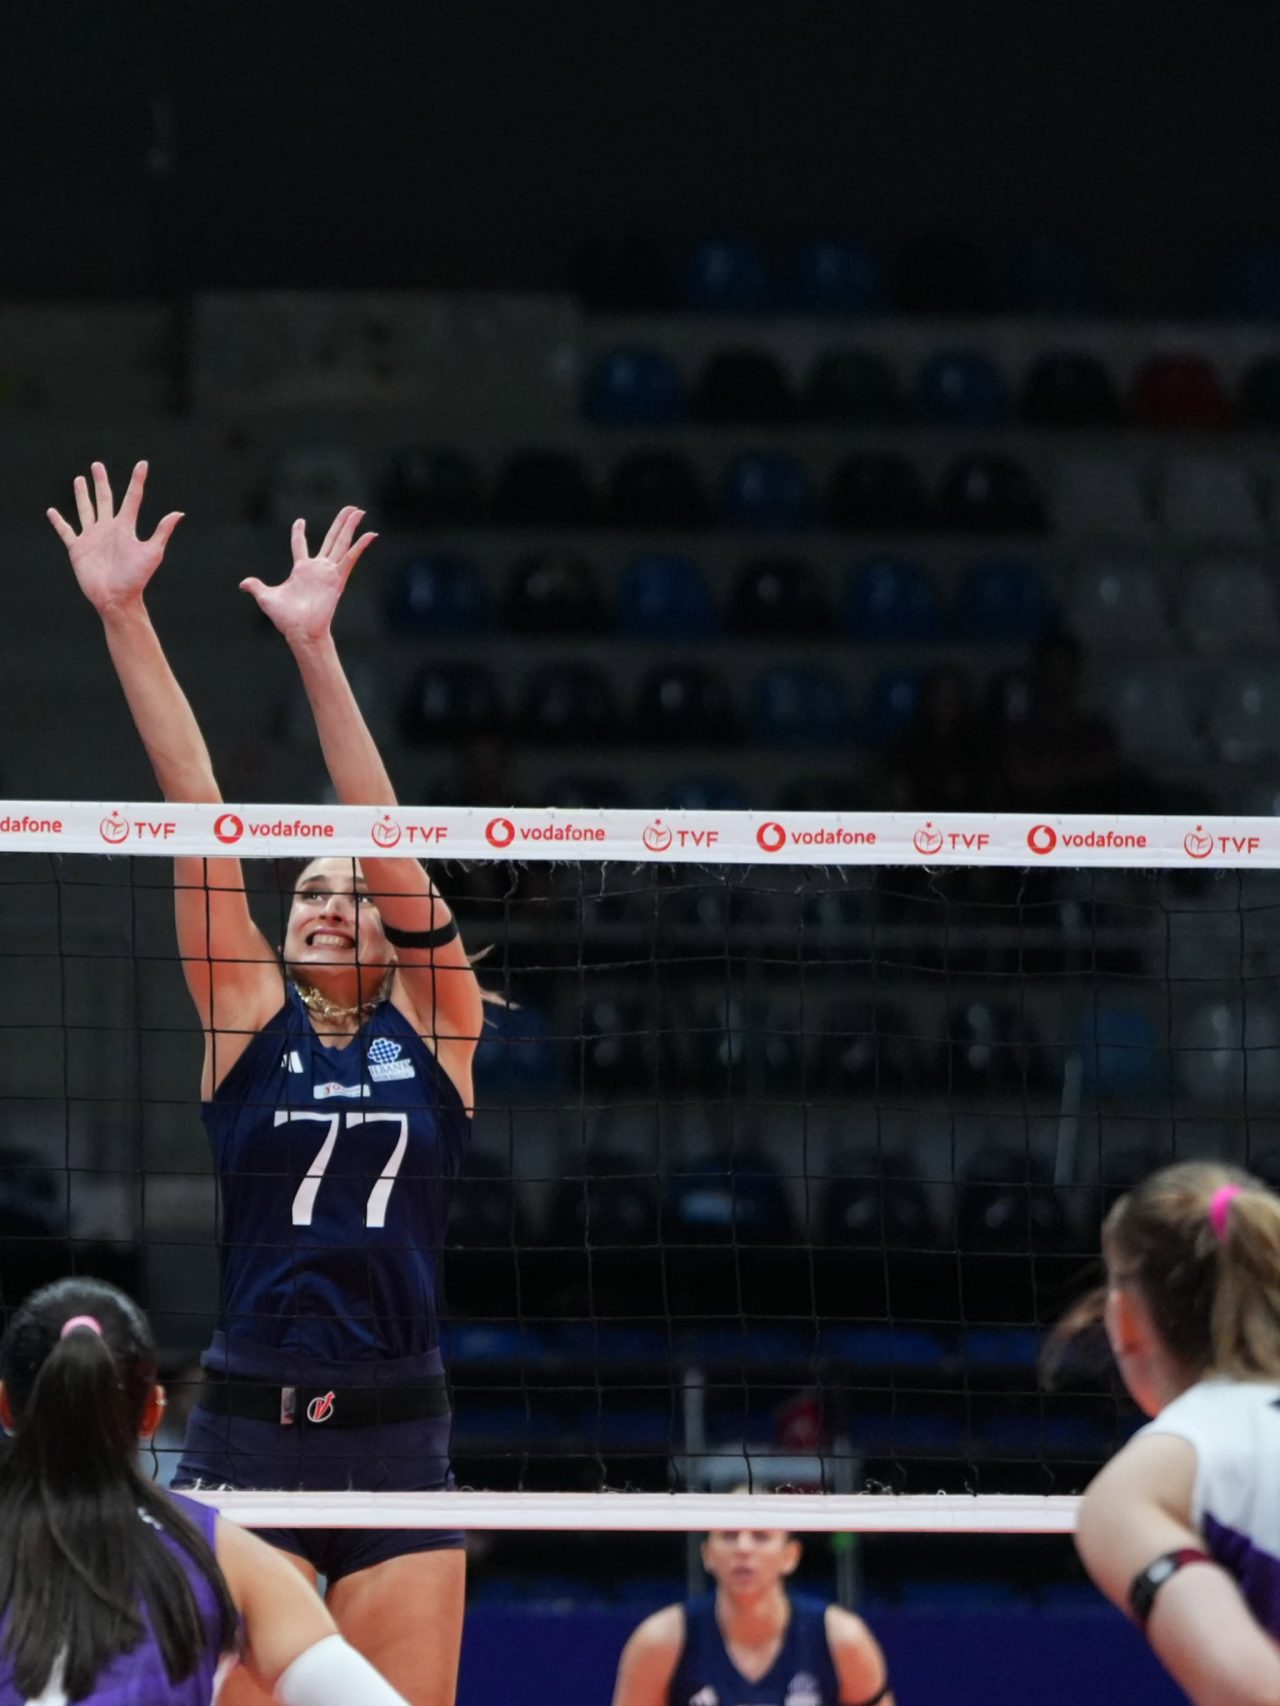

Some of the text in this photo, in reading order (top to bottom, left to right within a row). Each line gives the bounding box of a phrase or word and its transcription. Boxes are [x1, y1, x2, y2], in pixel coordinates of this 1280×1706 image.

[134, 820, 176, 838] TVF
[249, 819, 335, 838] vodafone
[405, 825, 448, 844] TVF
[520, 824, 606, 842] vodafone
[791, 828, 877, 846] vodafone
[677, 830, 719, 848] TVF
[947, 832, 990, 850] TVF
[1062, 831, 1148, 849] vodafone
[1217, 836, 1260, 854] TVF
[273, 1110, 408, 1228] 77
